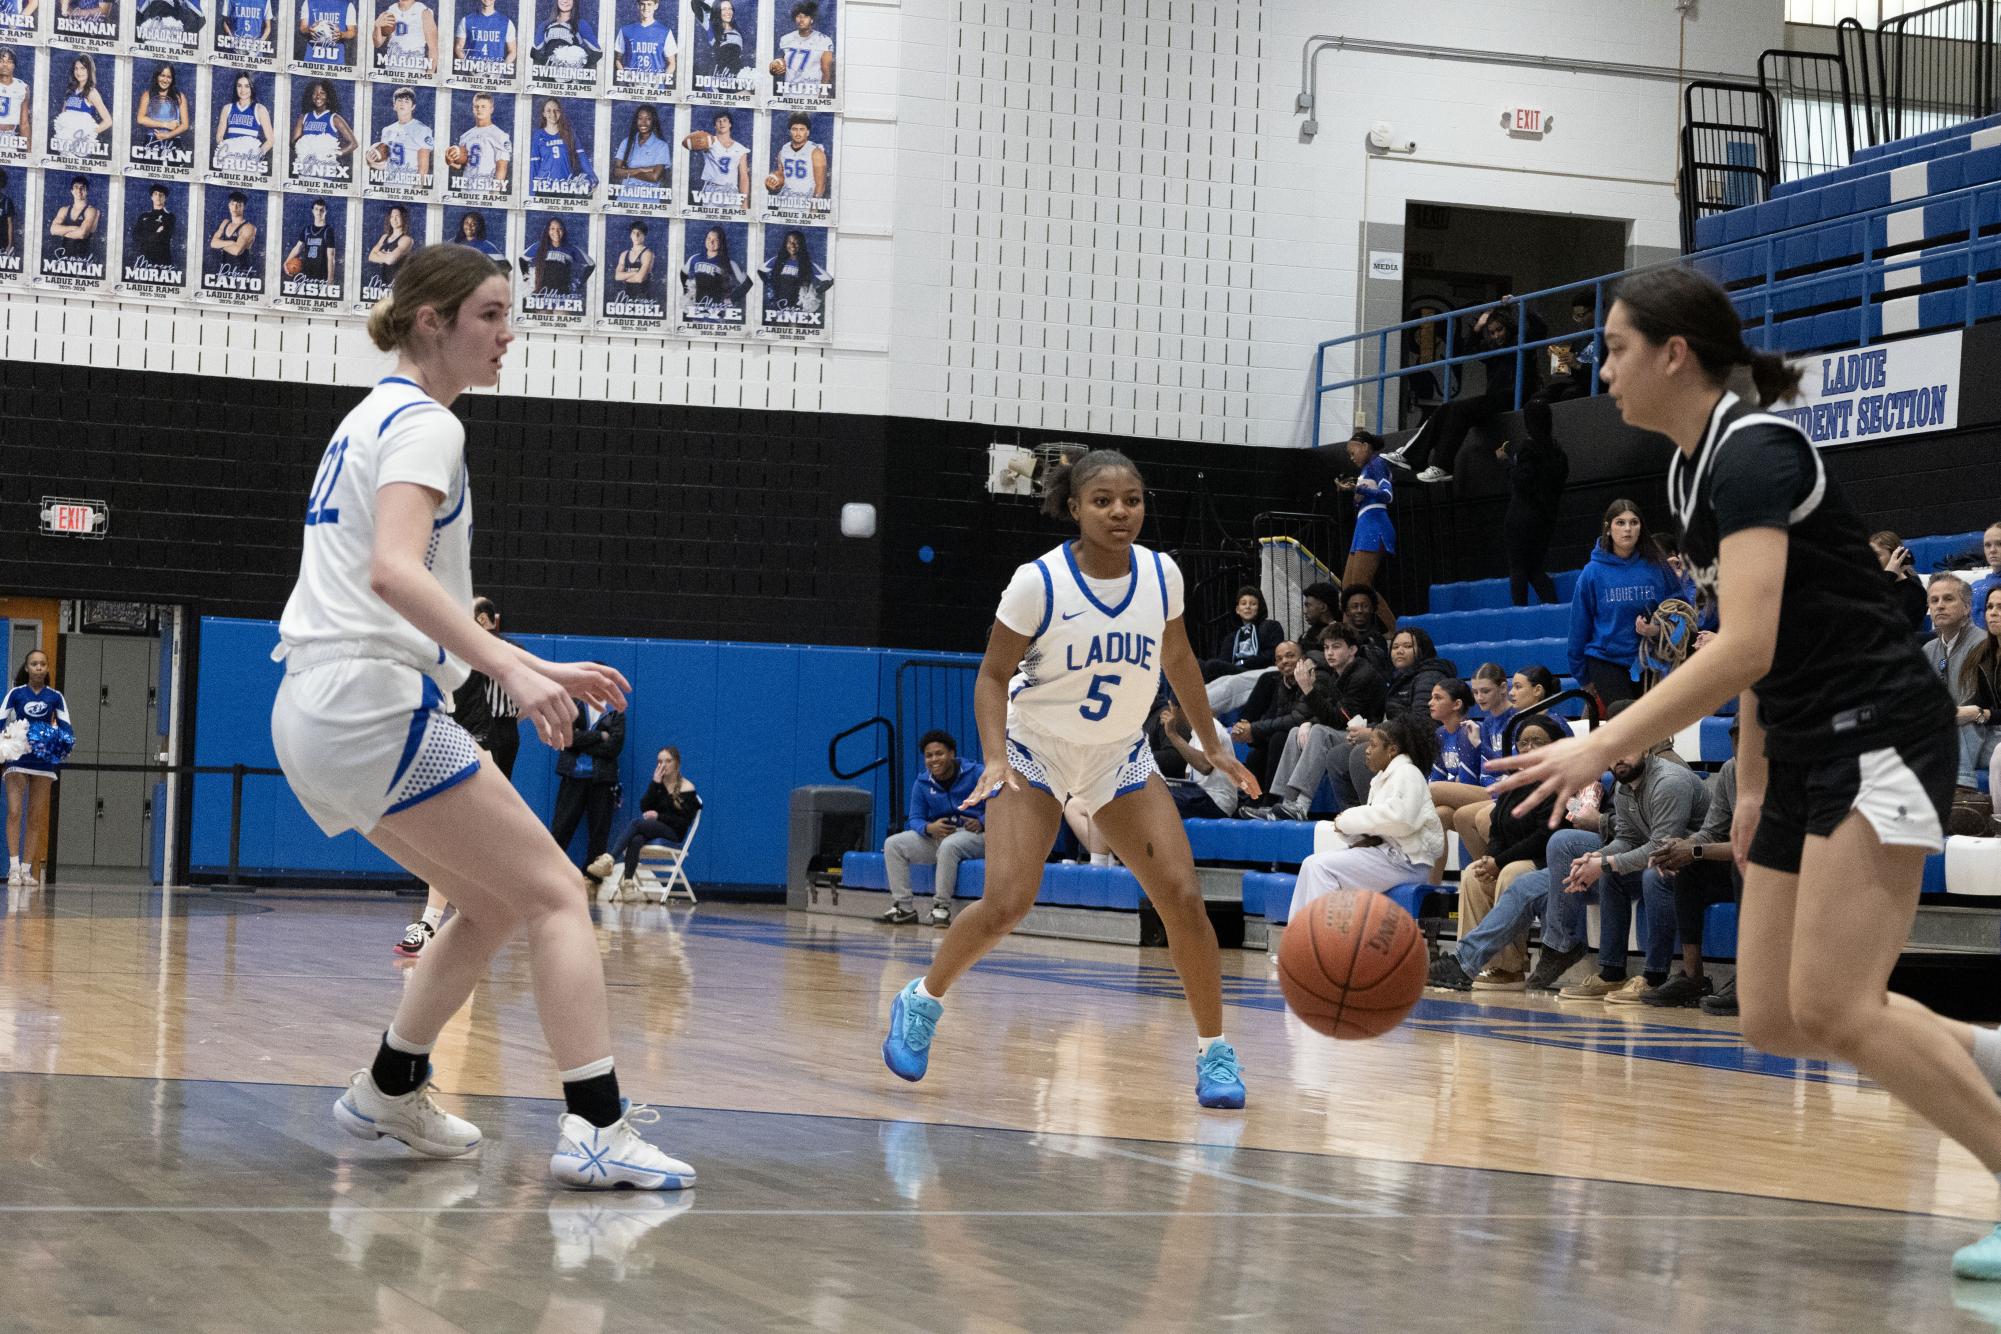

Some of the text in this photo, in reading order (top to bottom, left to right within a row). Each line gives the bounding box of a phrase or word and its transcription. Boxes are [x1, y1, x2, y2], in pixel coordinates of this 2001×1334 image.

[235, 6, 260, 19] LADUE
[314, 12, 340, 24] LADUE
[57, 18, 116, 36] BRENNAN
[244, 20, 250, 31] 5
[8, 30, 33, 38] RAMS
[472, 30, 500, 42] LADUE
[58, 36, 114, 47] LADUE RAMS
[139, 45, 193, 56] LADUE RAMS
[313, 48, 339, 59] DU
[482, 44, 488, 55] 4
[631, 42, 658, 54] LADUE
[218, 54, 272, 65] LADUE RAMS
[377, 53, 433, 69] MARDEN
[638, 56, 650, 67] 26
[788, 48, 810, 71] 77
[297, 63, 352, 73] LADUE RAMS
[454, 59, 514, 74] SUMMERS
[378, 70, 432, 80] LADUE RAMS
[456, 76, 511, 86] LADUE RAMS
[537, 82, 564, 90] LADUE
[696, 75, 755, 90] DOUGHTY
[777, 82, 832, 95] HURT
[617, 87, 644, 95] LADUE
[1517, 109, 1541, 130] EXIT
[1, 152, 26, 160] RAMS
[132, 146, 192, 162] CHAN
[552, 146, 560, 159] 9
[51, 156, 107, 167] LADUE RAMS
[213, 157, 268, 173] CROSS
[134, 165, 189, 175] LADUE RAMS
[784, 159, 807, 178] 56
[213, 173, 267, 183] LADUE RAMS
[424, 174, 433, 185] IV
[452, 176, 508, 191] HENSLEY
[293, 180, 348, 190] LADUE RAMS
[533, 179, 589, 195] REAGAN
[403, 188, 428, 196] RAMS
[772, 211, 798, 219] LADUE
[43, 259, 102, 276] MANLIN
[1373, 263, 1398, 271] MEDIA
[125, 267, 182, 283] MORAN
[46, 276, 99, 287] LADUE RAMS
[205, 274, 261, 290] CAITO
[127, 284, 179, 294] LADUE RAMS
[283, 281, 340, 297] BISIG
[206, 291, 258, 301] LADUE RAMS
[285, 298, 337, 308] LADUE RAMS
[526, 297, 582, 311] BUTLER
[606, 302, 663, 316] GOEBEL
[765, 310, 821, 324] PINEX
[1822, 349, 1887, 396] LADUE
[1856, 384, 1948, 436] SECTION
[59, 507, 88, 529] EXIT
[1067, 632, 1155, 671] LADUE
[1079, 674, 1121, 722] 5
